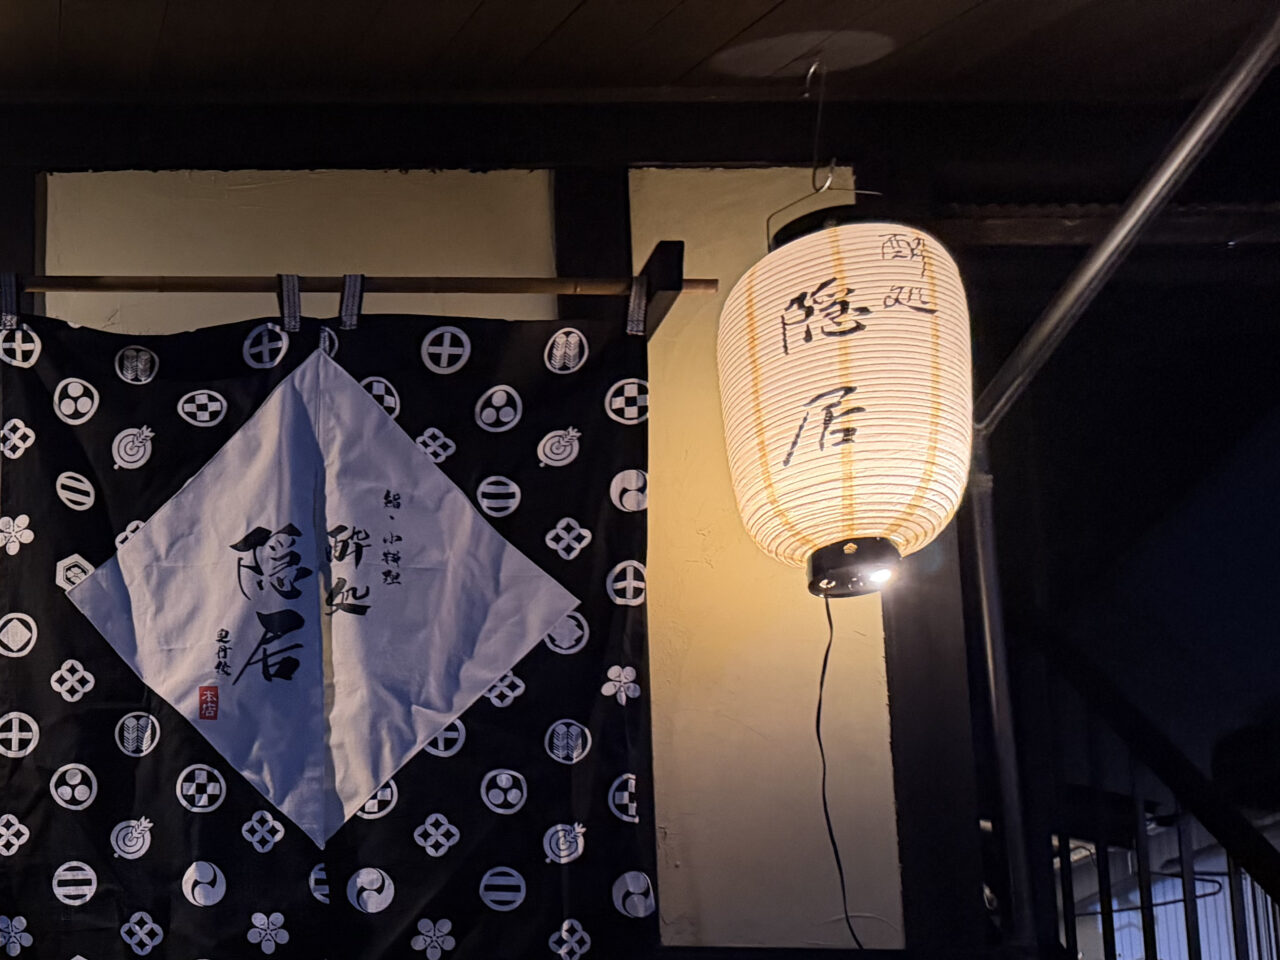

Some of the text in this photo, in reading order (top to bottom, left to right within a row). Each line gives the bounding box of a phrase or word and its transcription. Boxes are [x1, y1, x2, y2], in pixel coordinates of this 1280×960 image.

[781, 277, 873, 467] 隠居
[229, 523, 314, 686] 隠居
[201, 690, 217, 717] 本店
